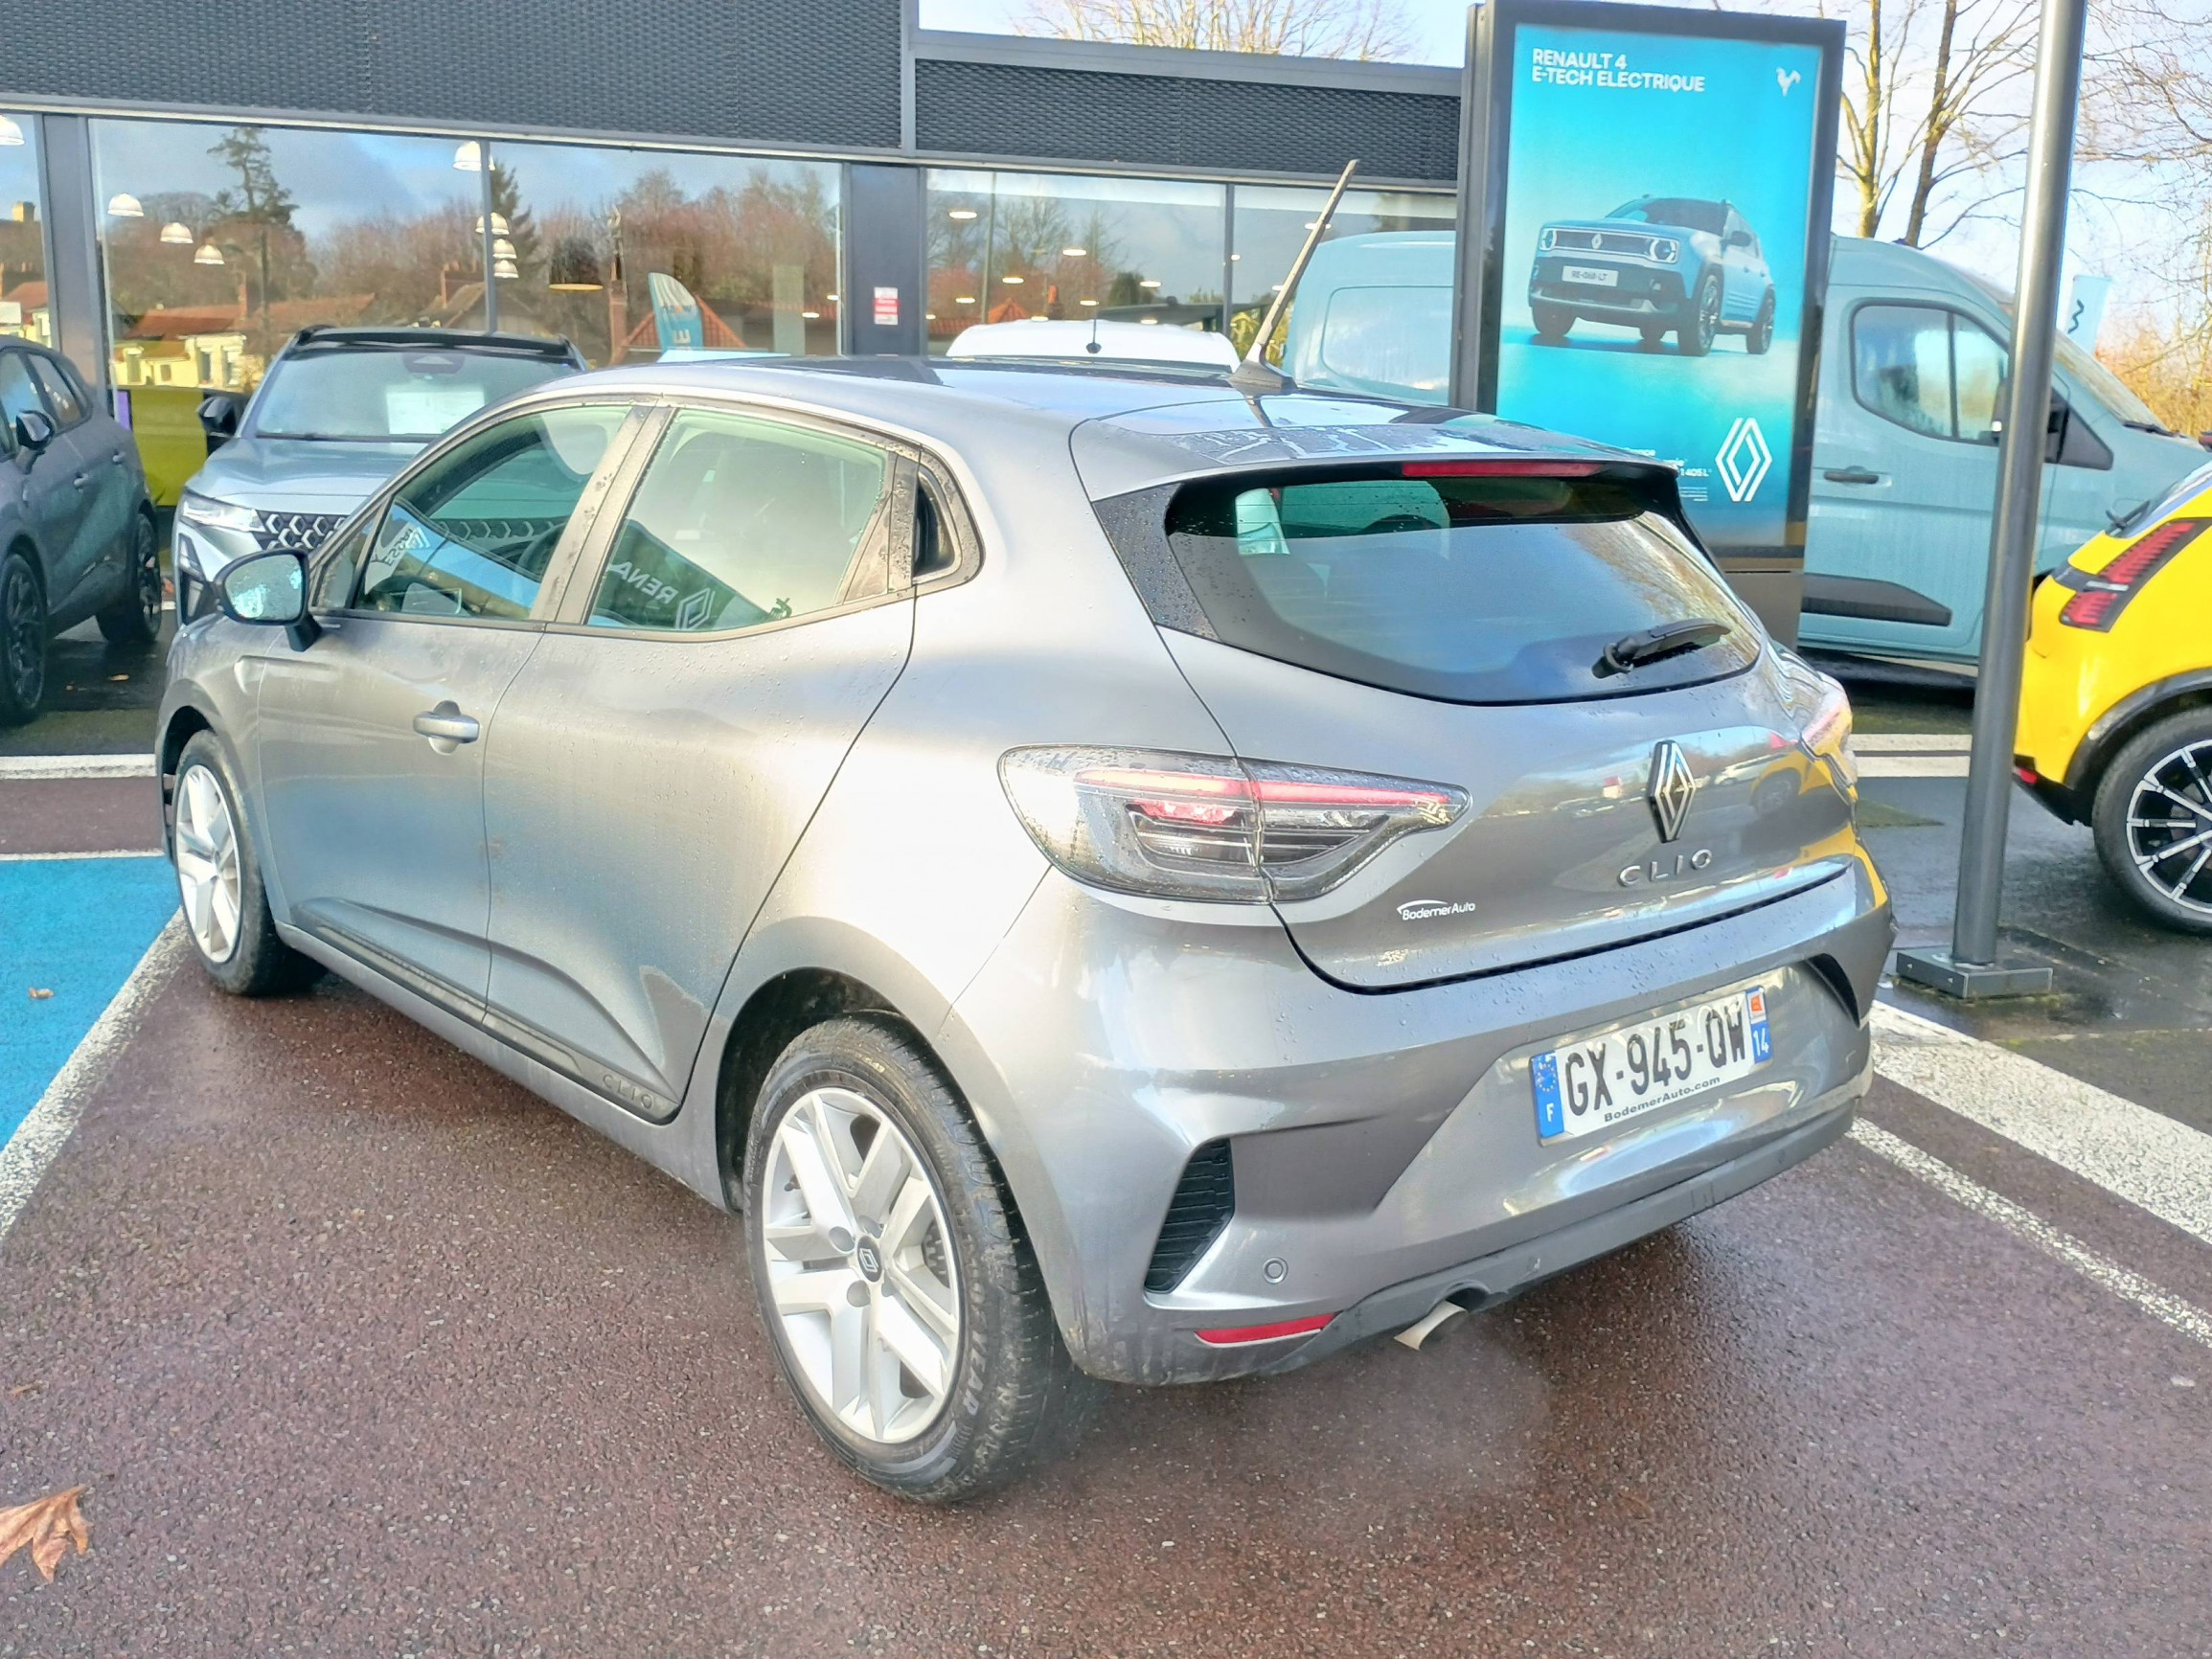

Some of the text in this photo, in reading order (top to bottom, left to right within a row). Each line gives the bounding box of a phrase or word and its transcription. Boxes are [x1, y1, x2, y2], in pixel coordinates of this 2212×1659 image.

[1533, 49, 1628, 70] RENAULT 4
[1533, 67, 1705, 92] E-TECH ELECTRIQUE
[1617, 849, 1713, 888] CLIO
[1402, 901, 1476, 920] BodemerAuto
[602, 1074, 653, 1110] CLIO
[1546, 1102, 1554, 1123] F
[1752, 1028, 1770, 1057] 14
[1604, 1076, 1722, 1123] BodemerAuto.com
